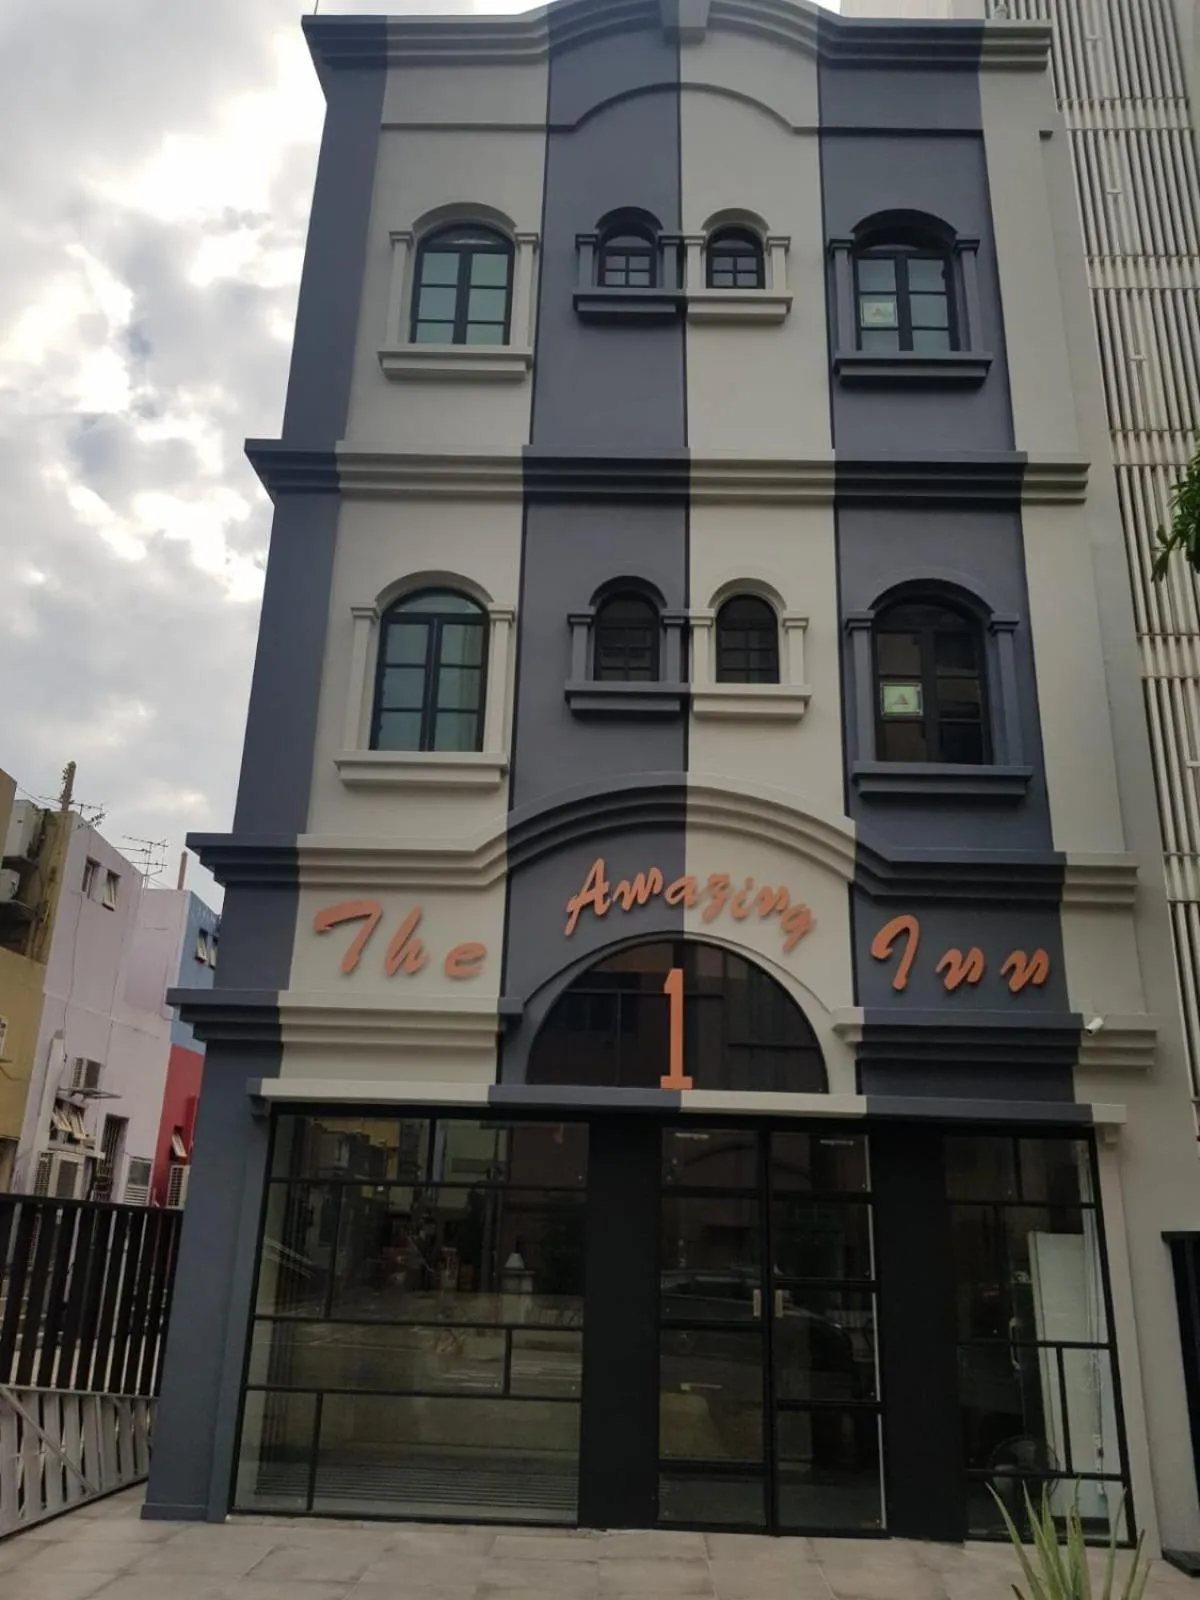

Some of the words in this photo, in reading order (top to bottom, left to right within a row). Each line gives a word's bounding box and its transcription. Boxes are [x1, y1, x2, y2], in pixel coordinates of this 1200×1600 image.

[313, 899, 486, 977] The
[564, 858, 816, 951] Amazing
[871, 914, 1049, 992] Inn
[660, 968, 693, 1090] 1
